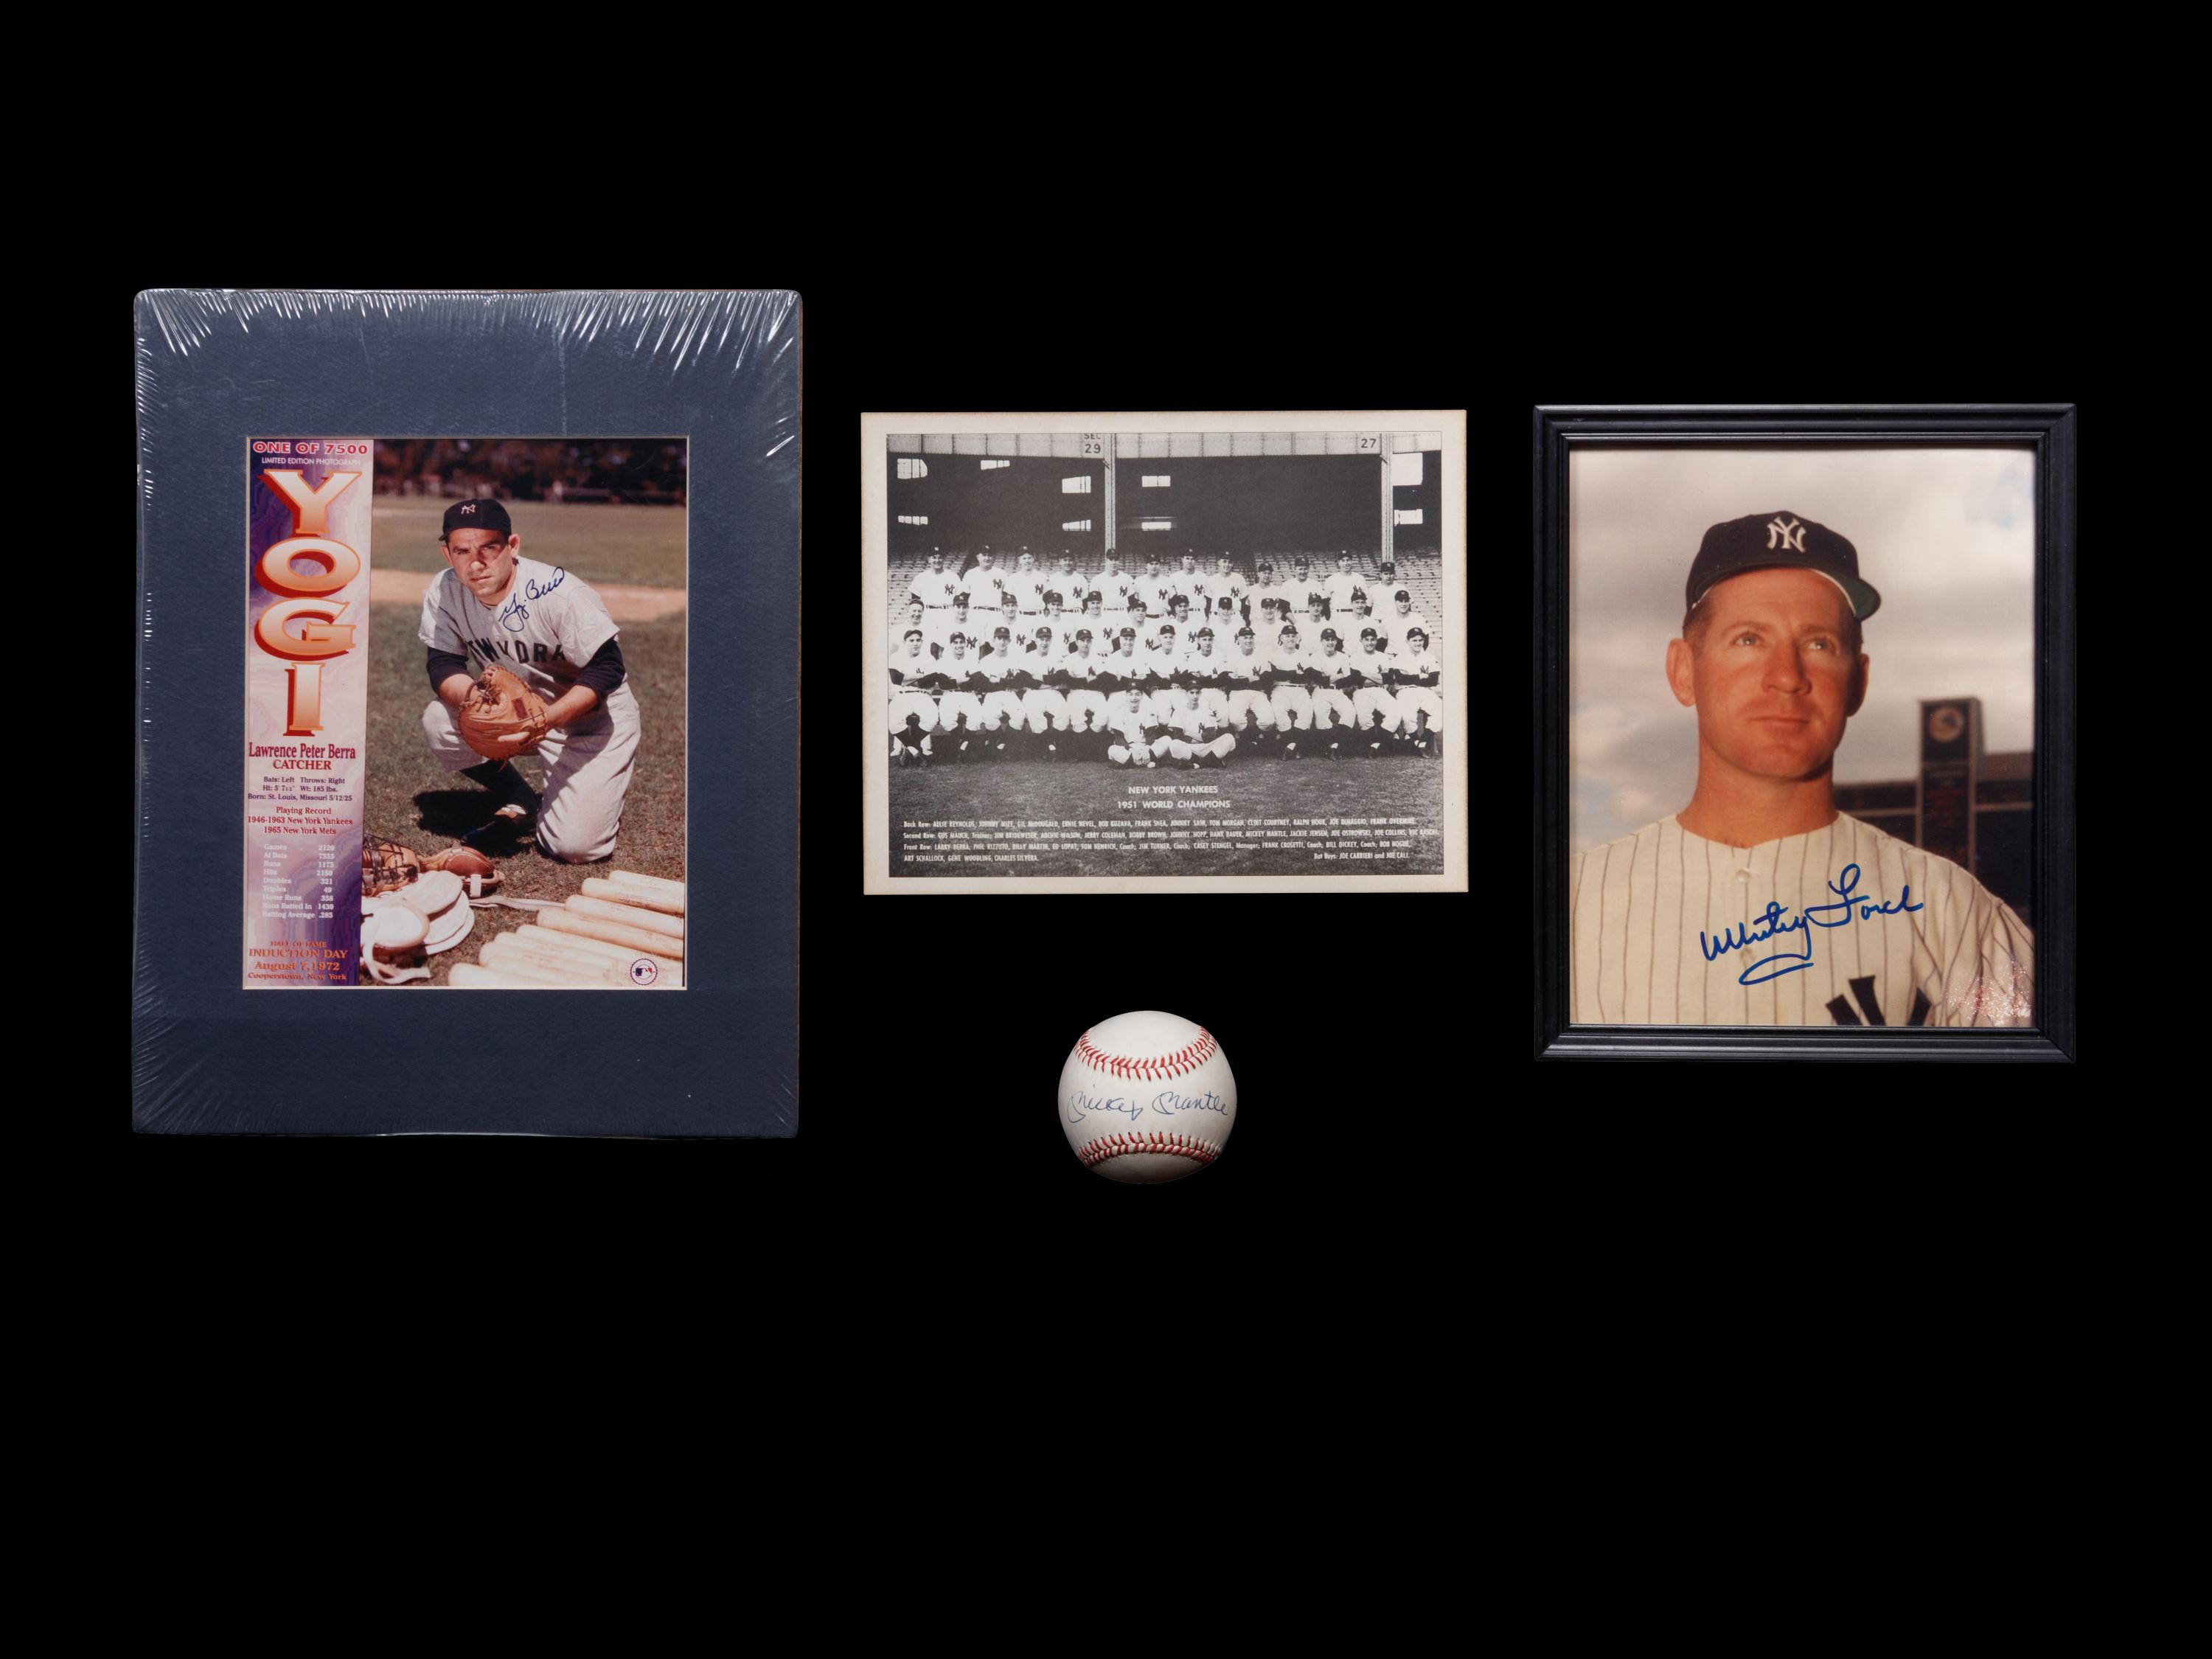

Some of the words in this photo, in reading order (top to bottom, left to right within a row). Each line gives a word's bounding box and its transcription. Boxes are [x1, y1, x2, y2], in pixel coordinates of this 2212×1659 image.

[253, 441, 291, 453] ONE
[296, 442, 319, 454] OF
[324, 444, 368, 454] 7500
[1085, 443, 1101, 453] 29
[1360, 438, 1377, 448] 27
[1767, 516, 1806, 553] NY
[254, 469, 362, 737] YOGI
[248, 742, 296, 757] Lawrence
[300, 743, 325, 758] Peter
[328, 744, 355, 759] Berra
[274, 759, 331, 770] CATCHER
[1128, 786, 1150, 794] NEW
[1152, 786, 1177, 794] YORK
[276, 807, 302, 815] Playing
[249, 949, 319, 958] INDUCTION
[324, 950, 348, 959] DAY
[254, 961, 296, 971] August
